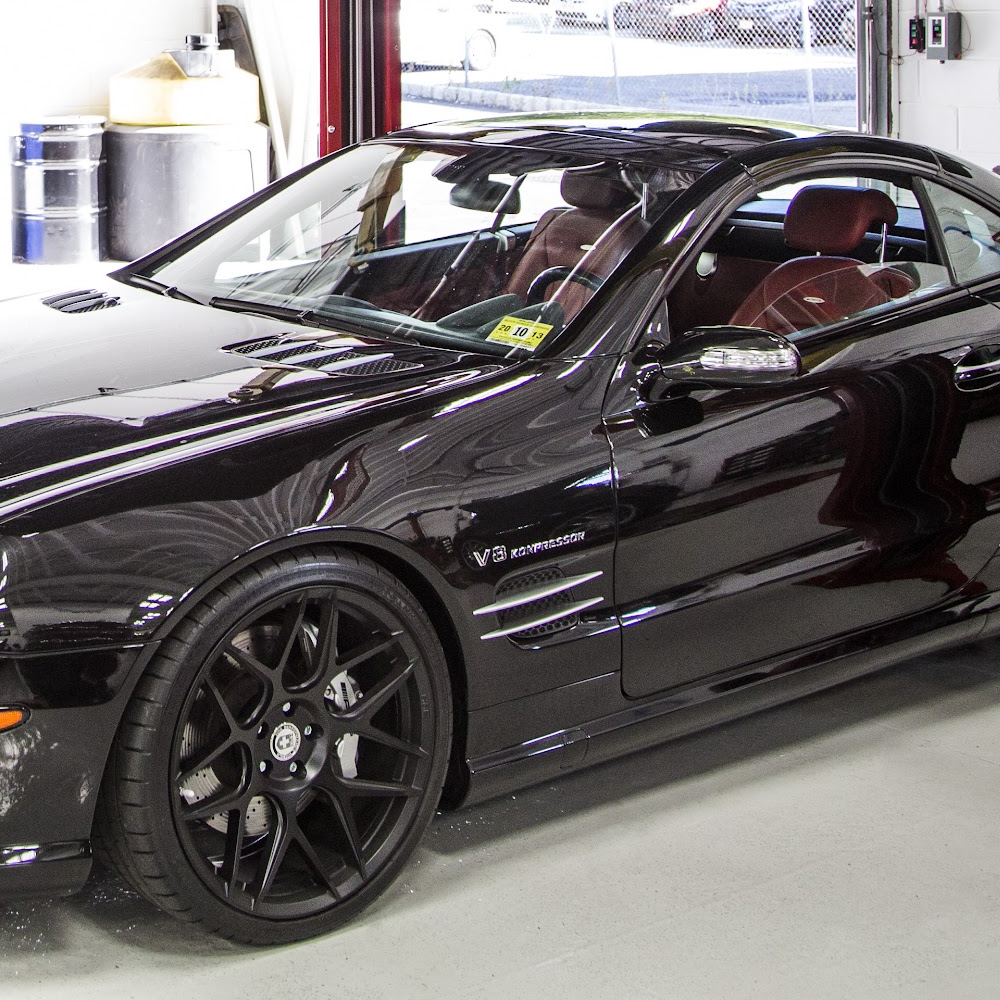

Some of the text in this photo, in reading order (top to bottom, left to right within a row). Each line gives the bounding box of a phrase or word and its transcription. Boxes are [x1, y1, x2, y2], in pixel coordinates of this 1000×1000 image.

[498, 324, 544, 339] 20 10 13
[473, 545, 507, 567] V8
